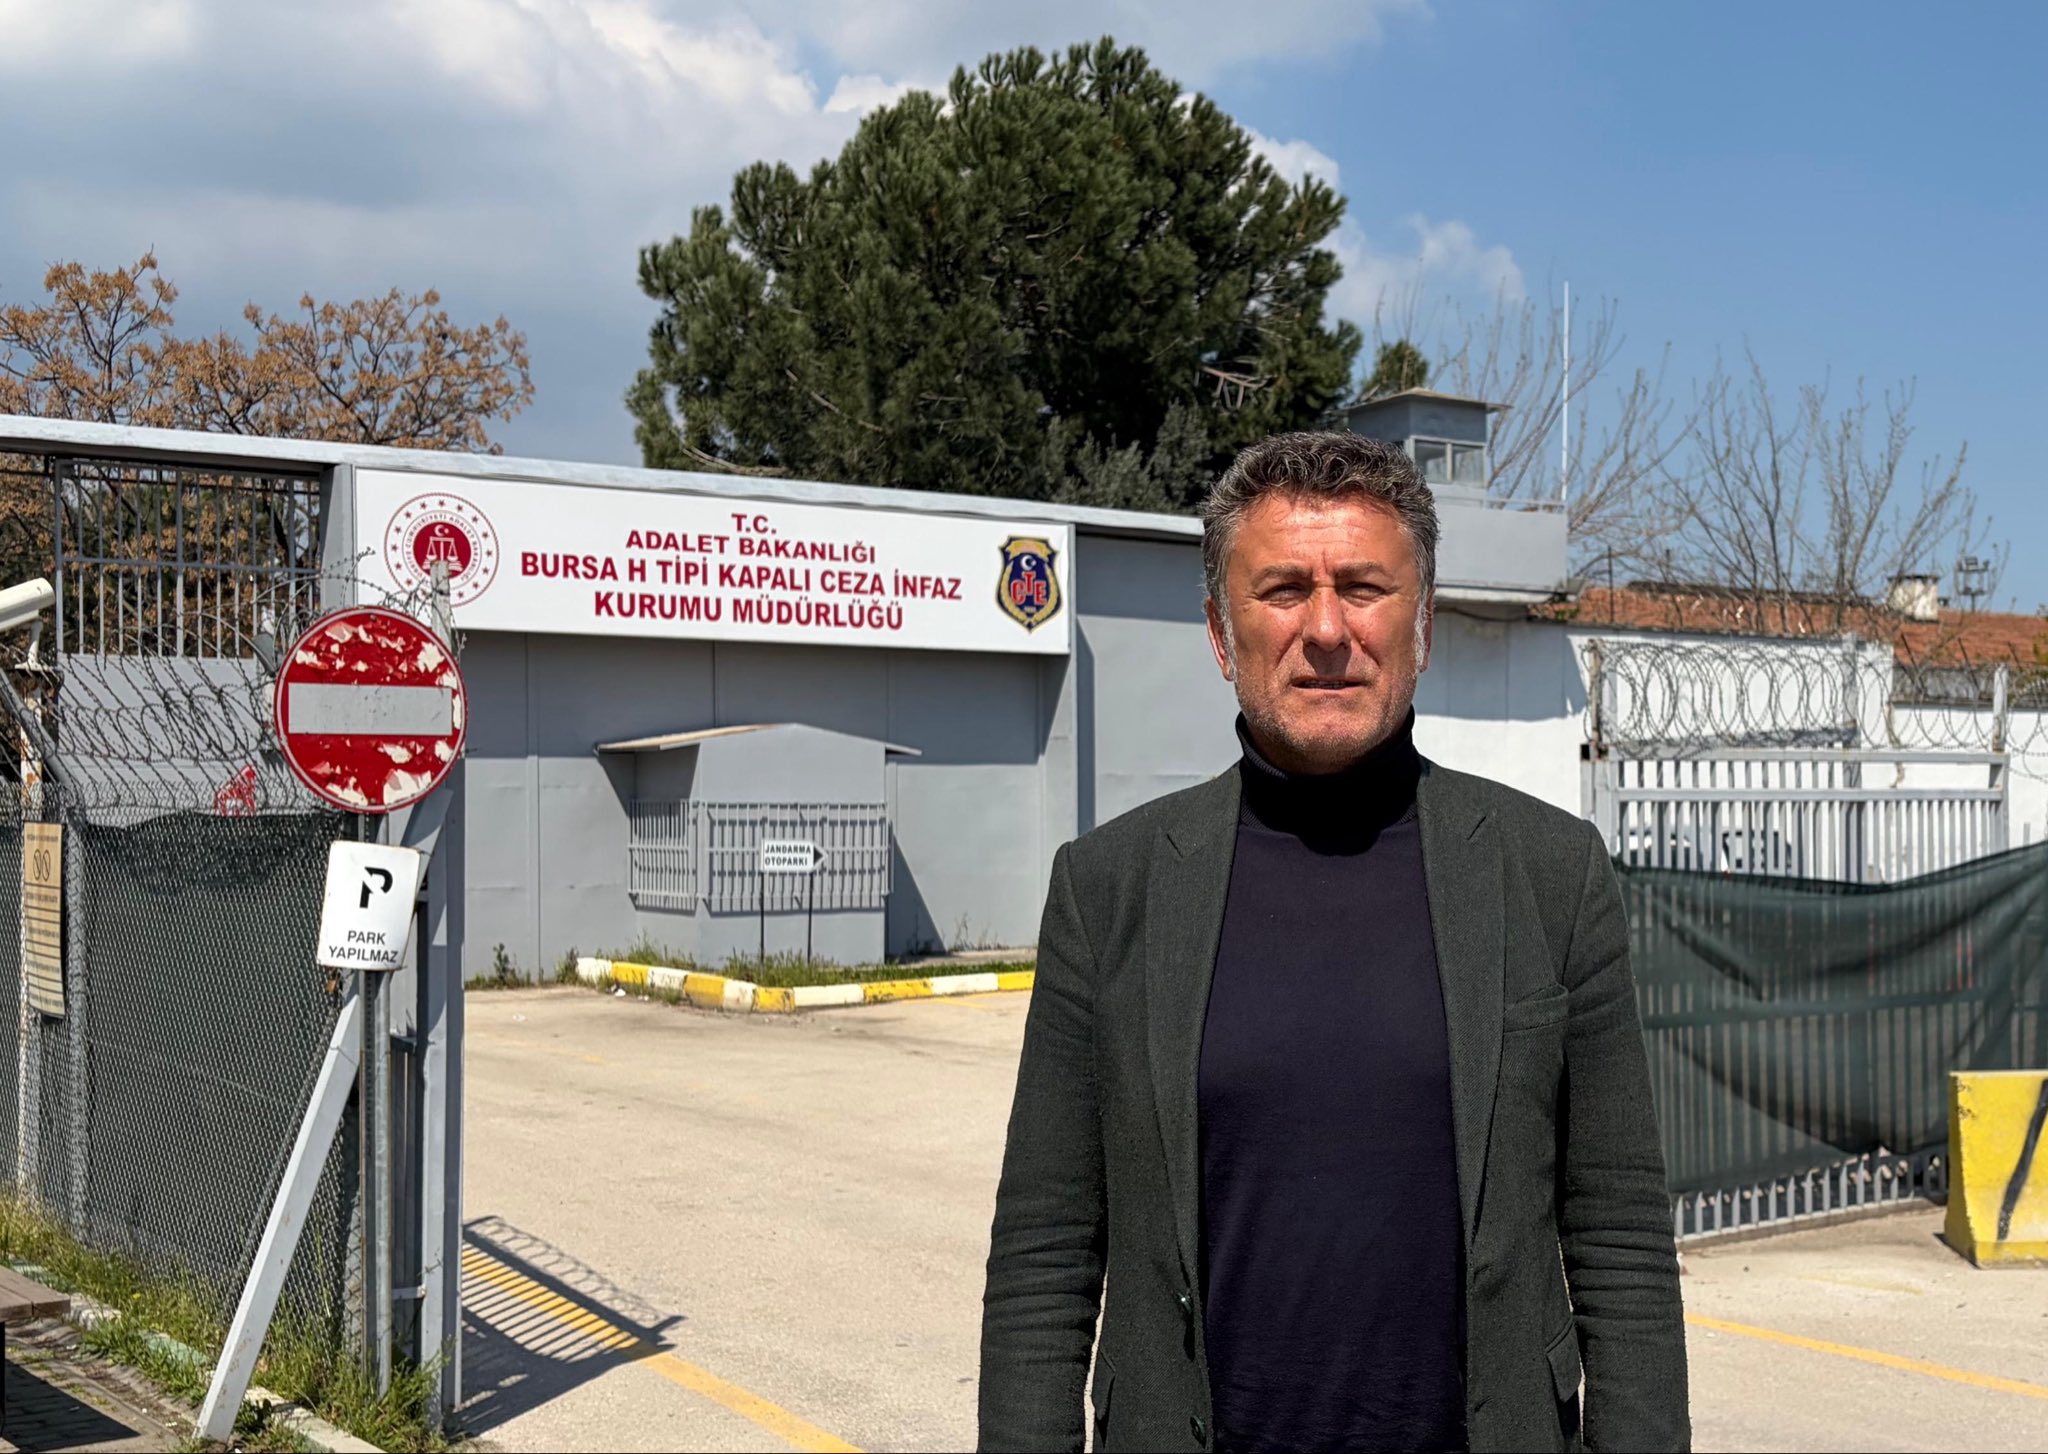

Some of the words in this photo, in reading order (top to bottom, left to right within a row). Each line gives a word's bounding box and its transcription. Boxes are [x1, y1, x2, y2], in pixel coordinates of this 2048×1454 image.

[730, 512, 777, 535] T.C.
[625, 529, 730, 555] ADALET
[738, 537, 876, 565] BAKANLIĞI
[521, 551, 619, 582] BURSA
[628, 557, 647, 583] H
[655, 554, 709, 587] TİPİ
[718, 563, 811, 593] KAPALI
[819, 569, 886, 597] CEZA
[893, 568, 963, 601] İNFAZ
[1010, 571, 1048, 606] CTE
[594, 590, 722, 622] KURUMU
[732, 593, 903, 631] MÜDÜRLÜĞÜ
[764, 857, 808, 866] OTOPARKI
[765, 844, 811, 854] JANDARMA
[359, 866, 394, 909] P
[347, 930, 386, 945] PARK
[328, 946, 399, 964] YAPILMAZ
